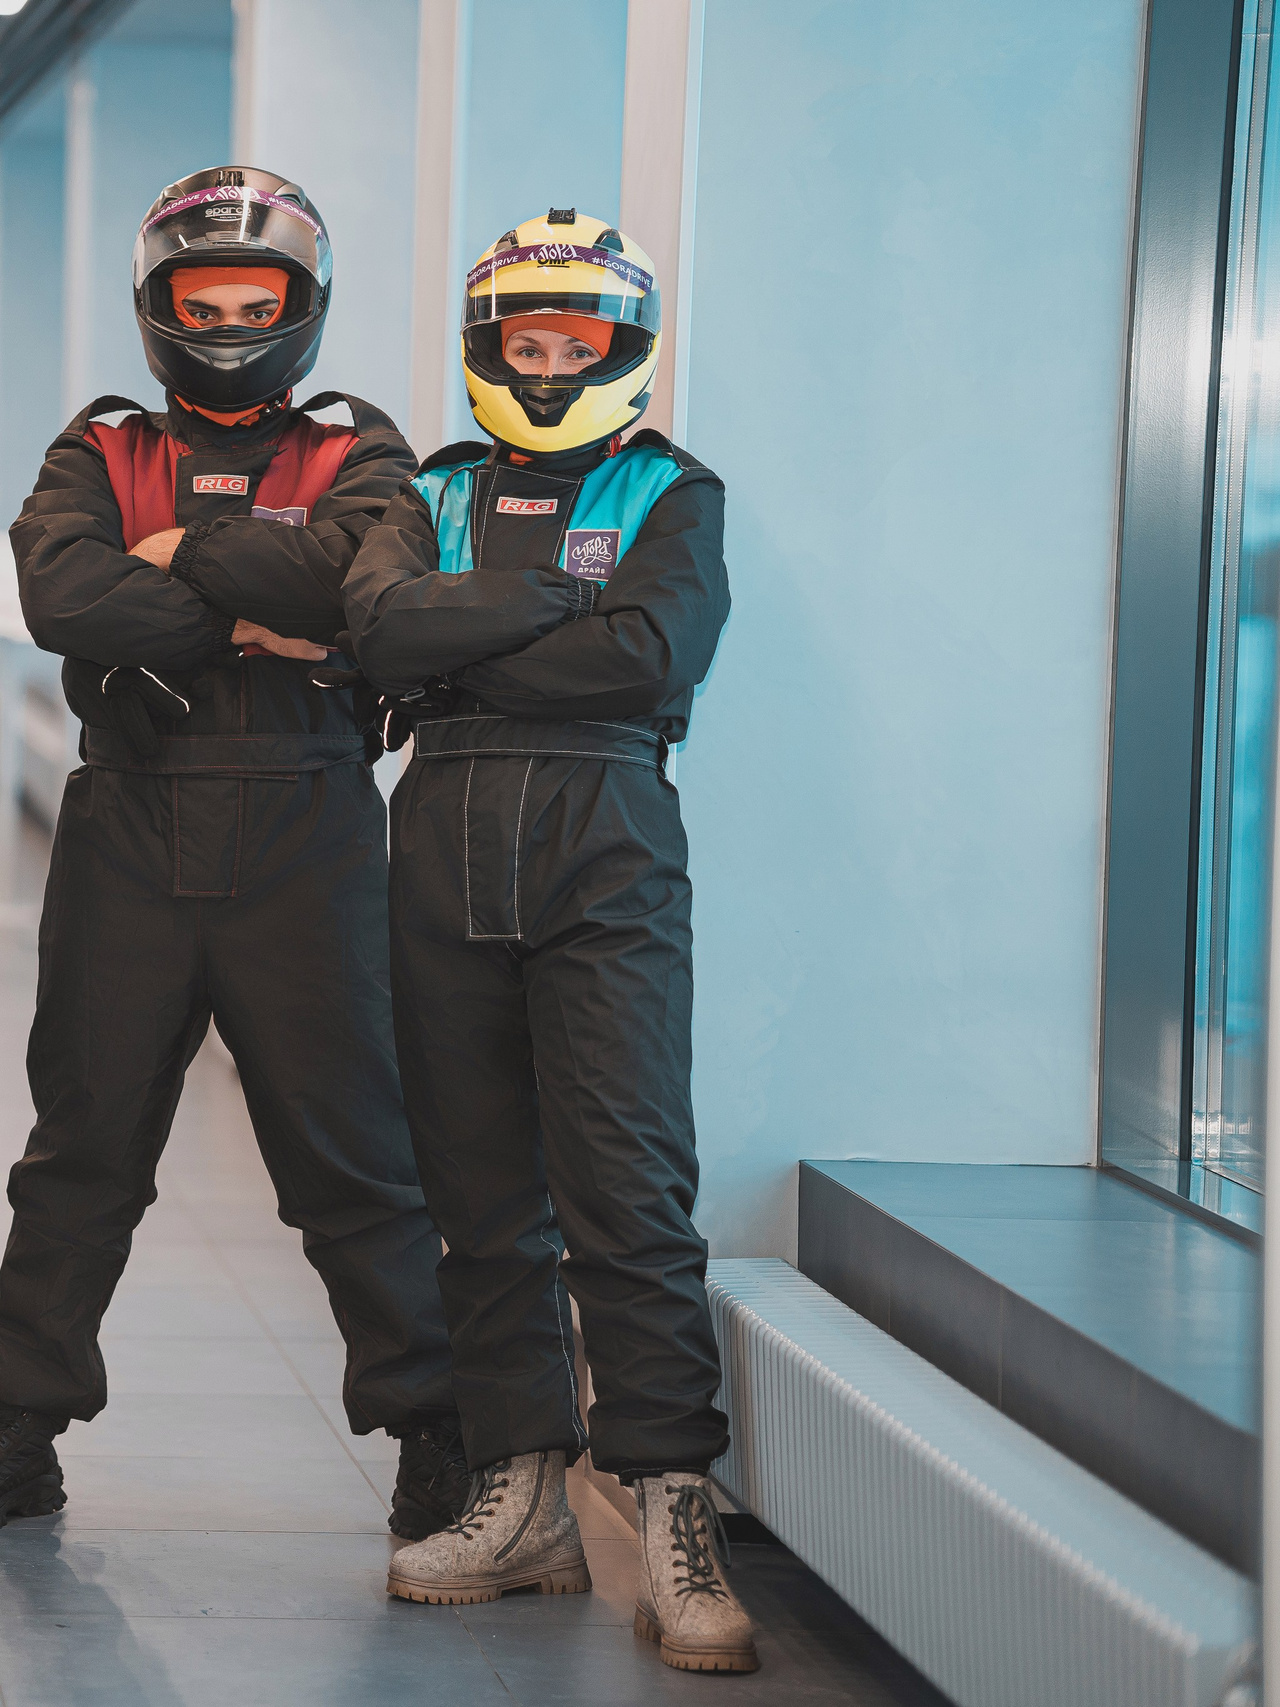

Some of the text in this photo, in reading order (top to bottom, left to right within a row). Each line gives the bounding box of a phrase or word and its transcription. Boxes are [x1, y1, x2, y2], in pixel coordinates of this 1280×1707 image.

[591, 256, 651, 288] #IGORADRIVE
[200, 478, 243, 491] RLG
[503, 501, 551, 511] RLG
